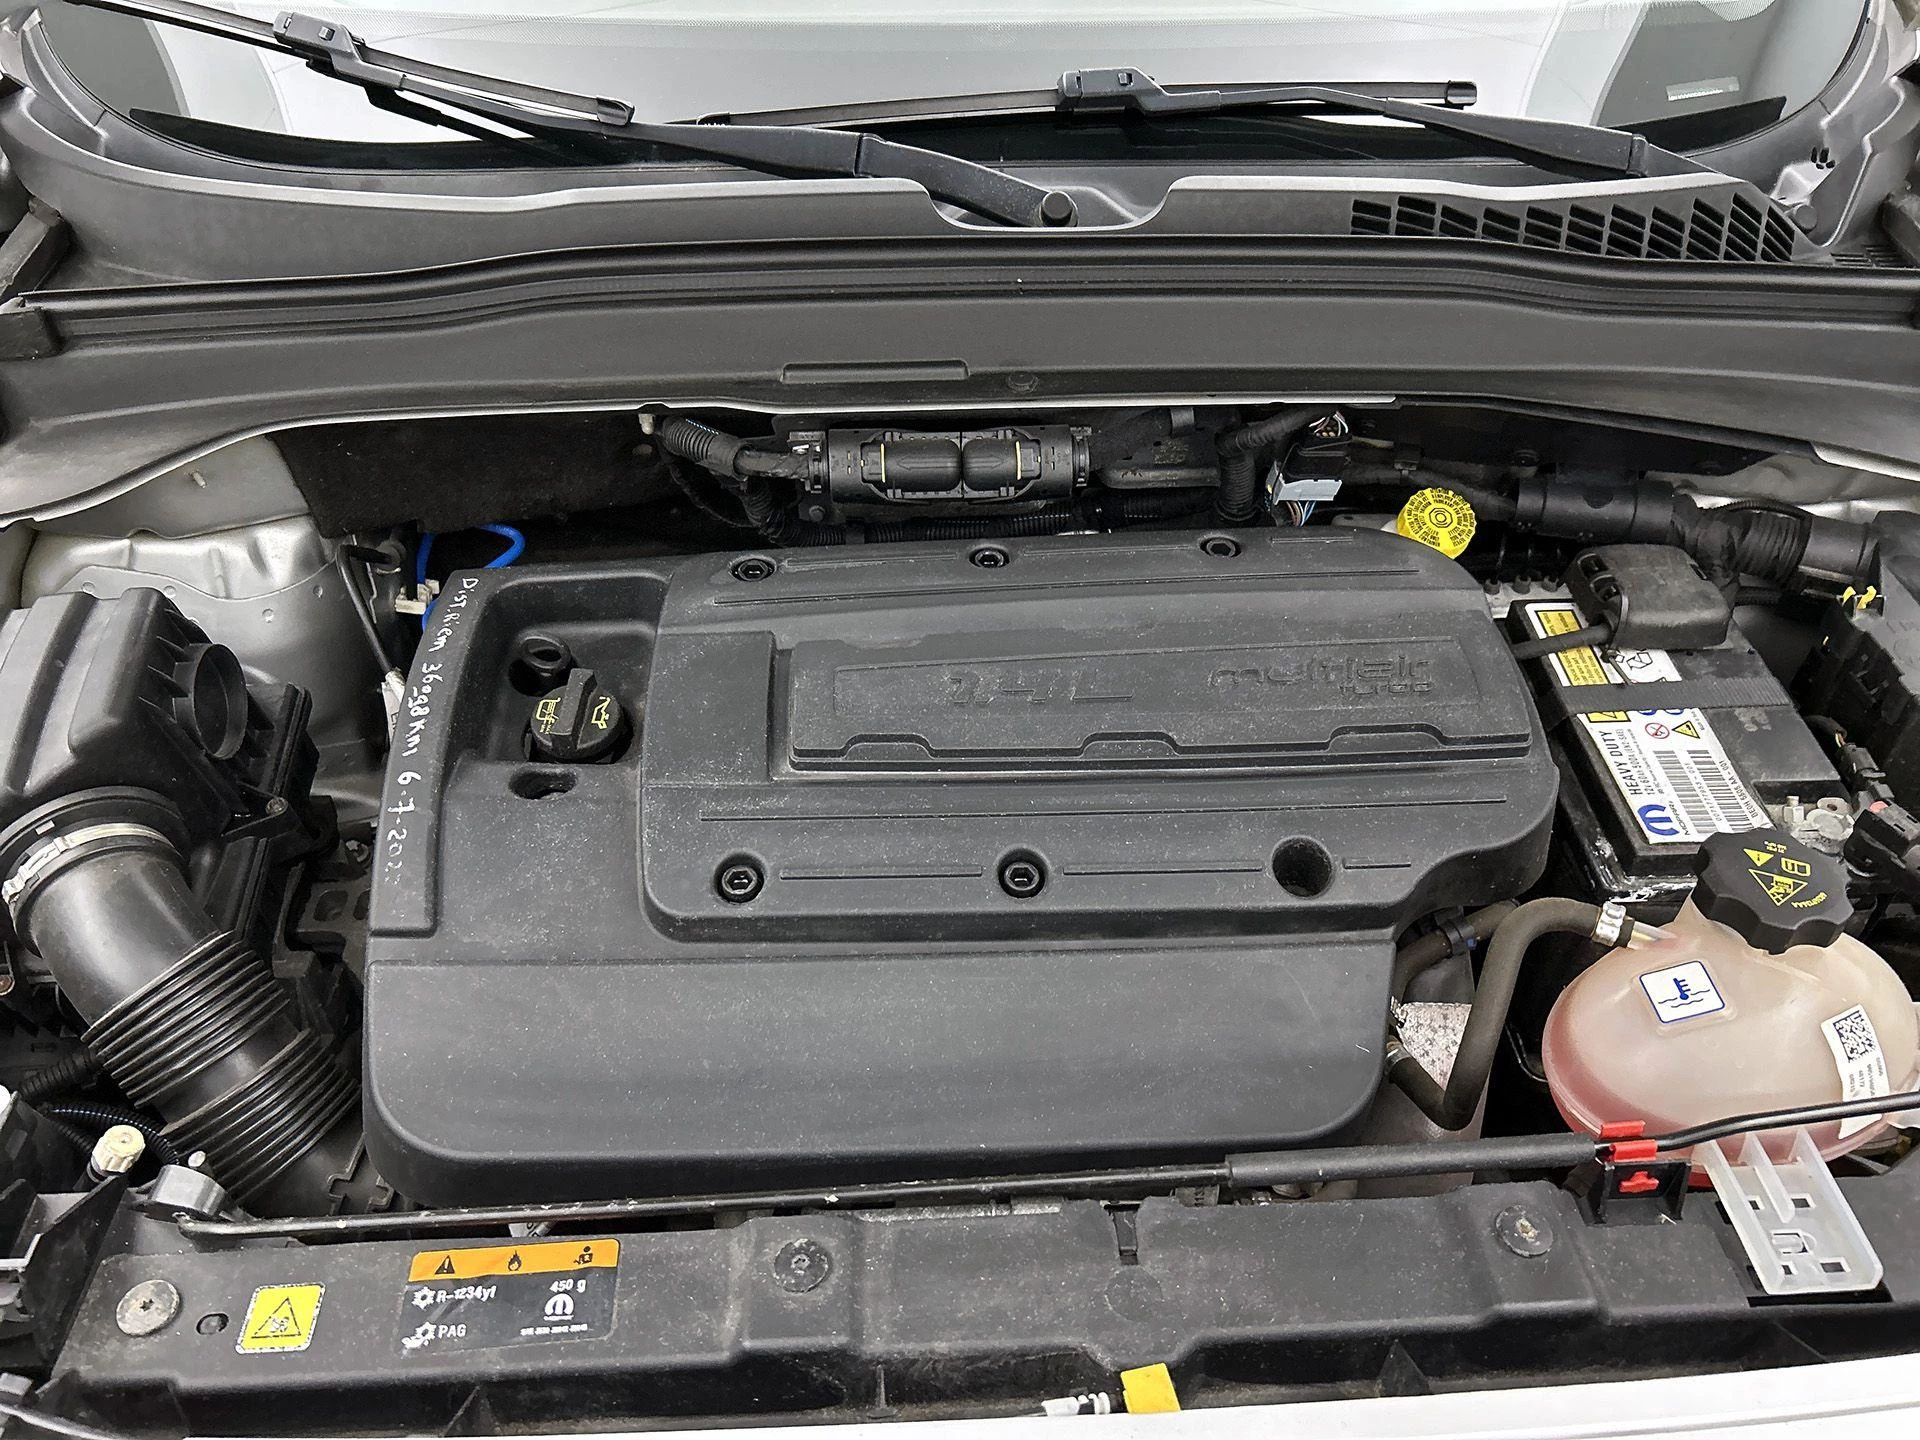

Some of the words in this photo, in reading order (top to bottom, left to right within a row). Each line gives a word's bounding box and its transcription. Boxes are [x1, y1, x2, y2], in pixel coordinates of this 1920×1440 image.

[1598, 730, 1623, 756] DUTY
[1614, 760, 1642, 795] HEAVY
[549, 1278, 574, 1293] 450
[576, 1279, 587, 1293] g
[438, 1323, 467, 1339] PAG
